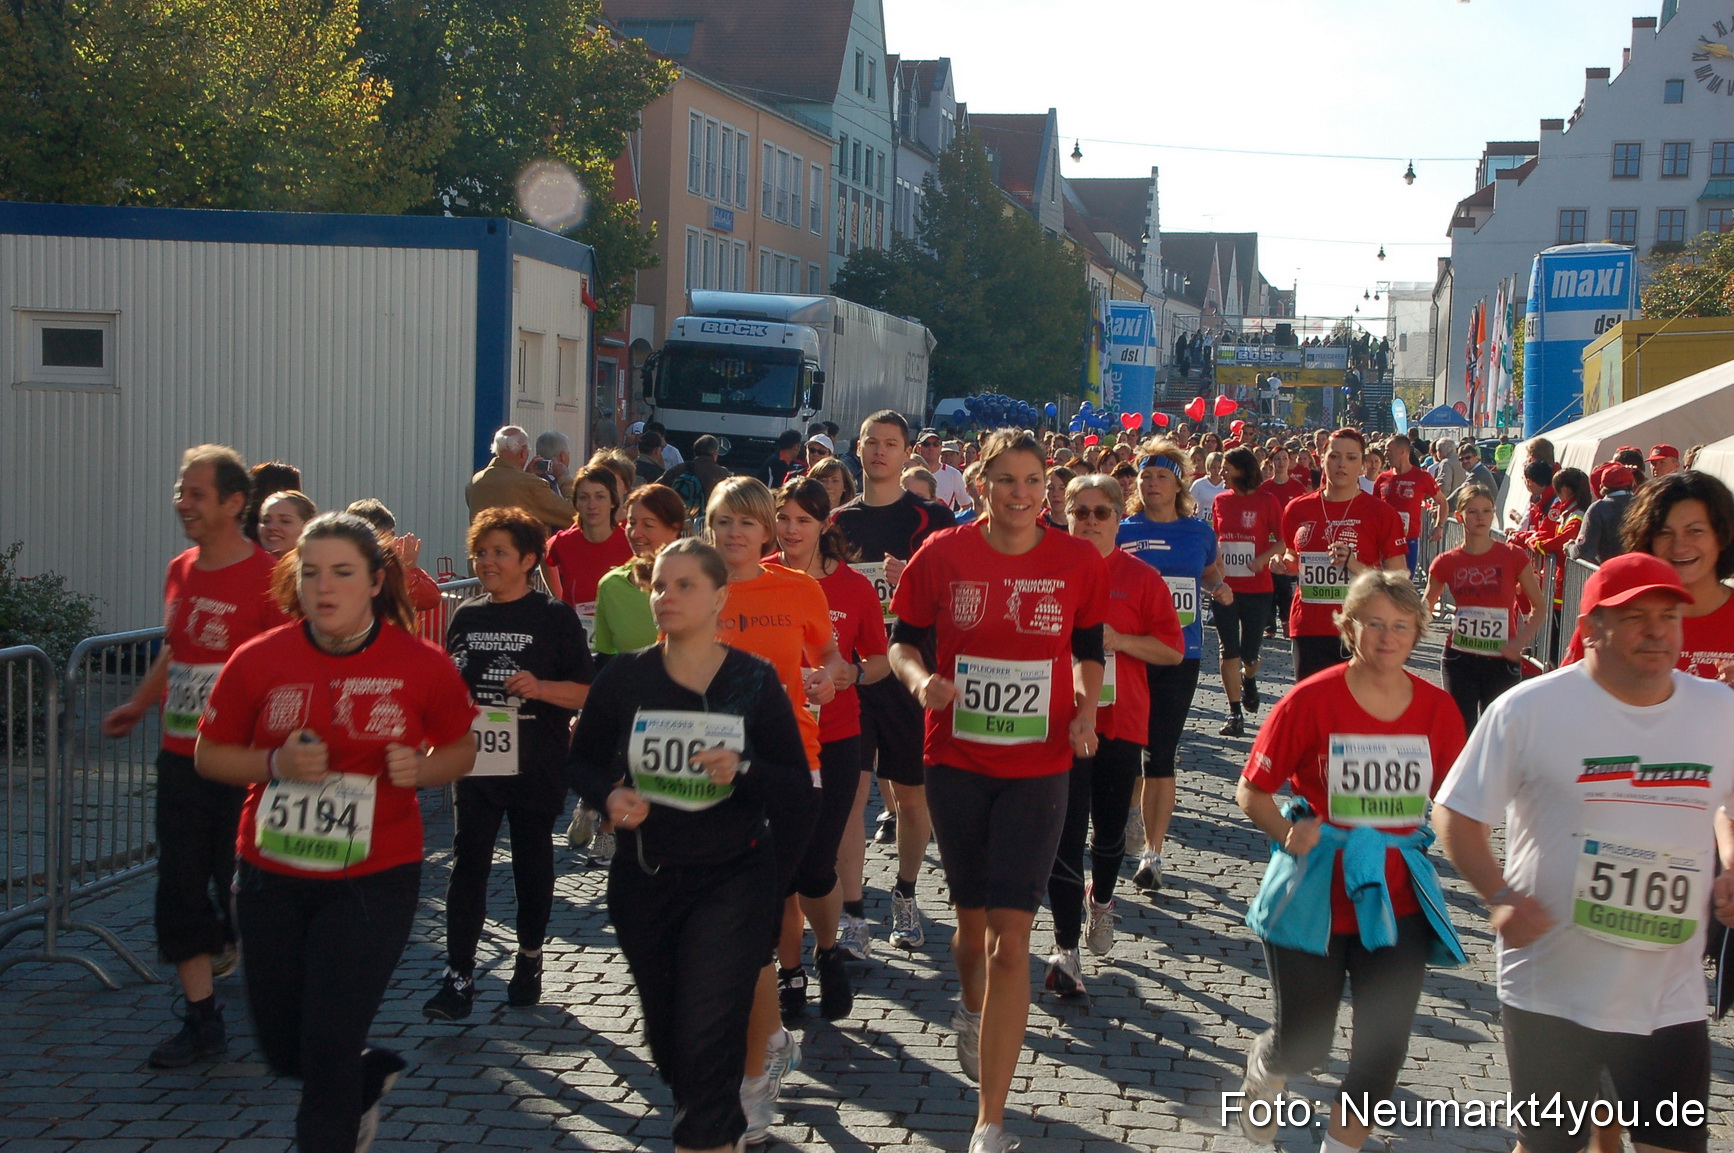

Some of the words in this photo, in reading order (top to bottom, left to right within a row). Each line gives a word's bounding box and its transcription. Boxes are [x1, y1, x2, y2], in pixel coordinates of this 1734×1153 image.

[1551, 262, 1625, 298] maxi
[701, 321, 768, 337] BOCK
[1121, 348, 1139, 362] dsl
[1236, 350, 1284, 362] BOCK
[1304, 566, 1350, 585] 5064
[1312, 586, 1340, 599] Sonja
[751, 615, 792, 627] POLES
[1457, 617, 1502, 638] 5152
[466, 632, 534, 644] NEUMARKTER
[468, 641, 526, 652] STADTLAUF
[1460, 635, 1499, 650] Melanie
[964, 679, 1041, 714] 5022
[986, 715, 1016, 734] Eva
[641, 738, 727, 775] 506
[1341, 760, 1421, 793] 5086
[265, 793, 358, 835] 5194
[1359, 797, 1405, 818] Tanja
[1589, 861, 1691, 915] 5169
[1588, 904, 1684, 940] Gottfried
